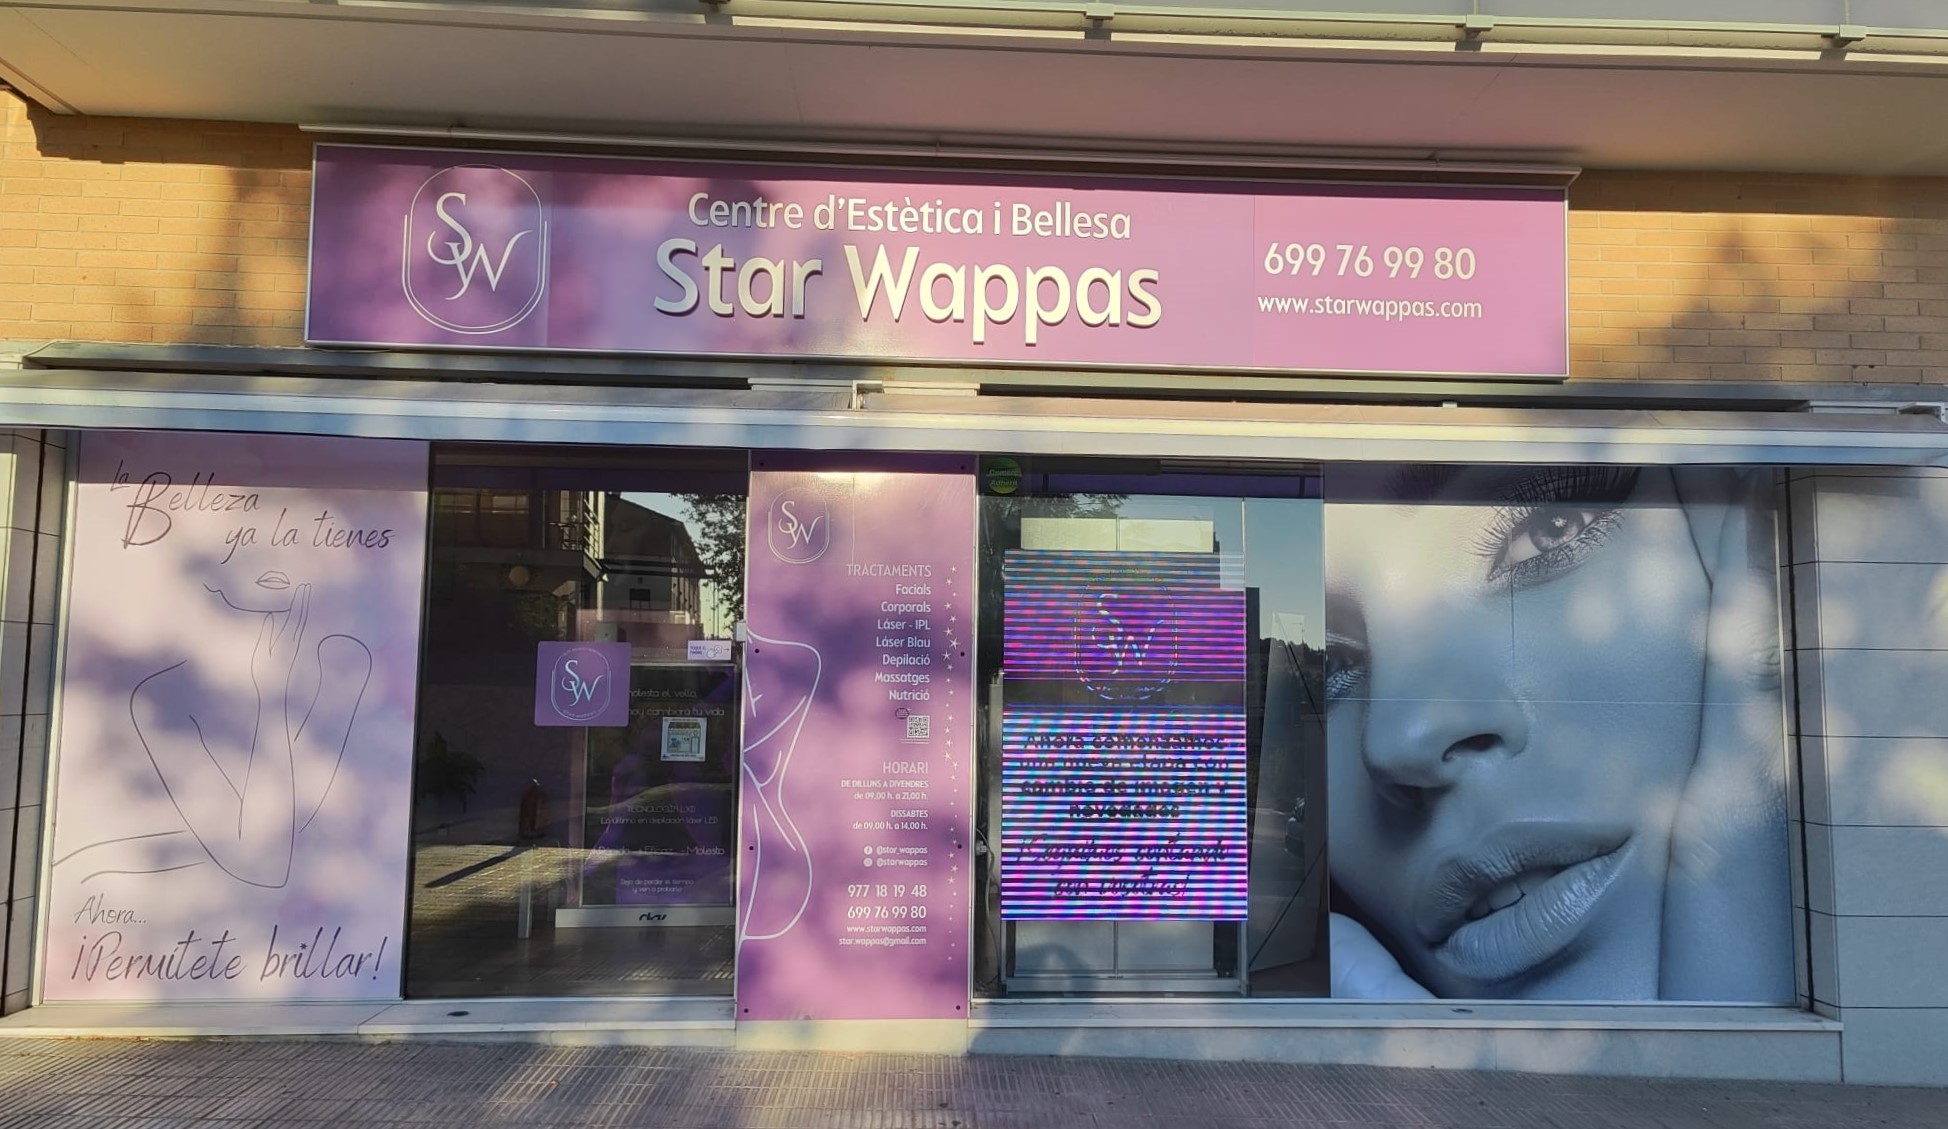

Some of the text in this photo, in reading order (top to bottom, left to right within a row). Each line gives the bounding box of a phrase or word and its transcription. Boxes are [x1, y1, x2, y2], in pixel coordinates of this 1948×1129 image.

[688, 192, 1131, 239] Centre d'Estètica i Bellesa
[1264, 243, 1476, 280] 699 76 99 80
[654, 237, 1162, 346] Star Wappas
[1257, 295, 1482, 321] www.starwappas.com
[110, 459, 130, 491] La
[121, 471, 260, 549] Belleza
[221, 507, 396, 564] ya la tienes
[846, 564, 932, 577] TRACTAMENTS
[896, 583, 932, 595] Facials
[881, 601, 931, 615] Corporals
[877, 618, 906, 630] Láser
[915, 619, 931, 630] IPL
[876, 636, 931, 648] Láser Blau
[882, 654, 931, 668] Depilació
[875, 672, 930, 686] Massatges
[889, 689, 930, 700] Nutrició
[882, 762, 928, 774] HORARI
[841, 780, 929, 788] DE DILLUNS A DIVENDRES
[854, 792, 863, 800] de
[891, 810, 928, 818] DISSABTES
[848, 885, 927, 897] 977 18 19 48
[74, 893, 147, 925] Ahora...
[847, 906, 927, 919] 699 76 99 80
[847, 925, 927, 935] www.starwappas.com
[839, 936, 927, 946] star.wappas@gmail.com
[260, 924, 388, 981] brillar!
